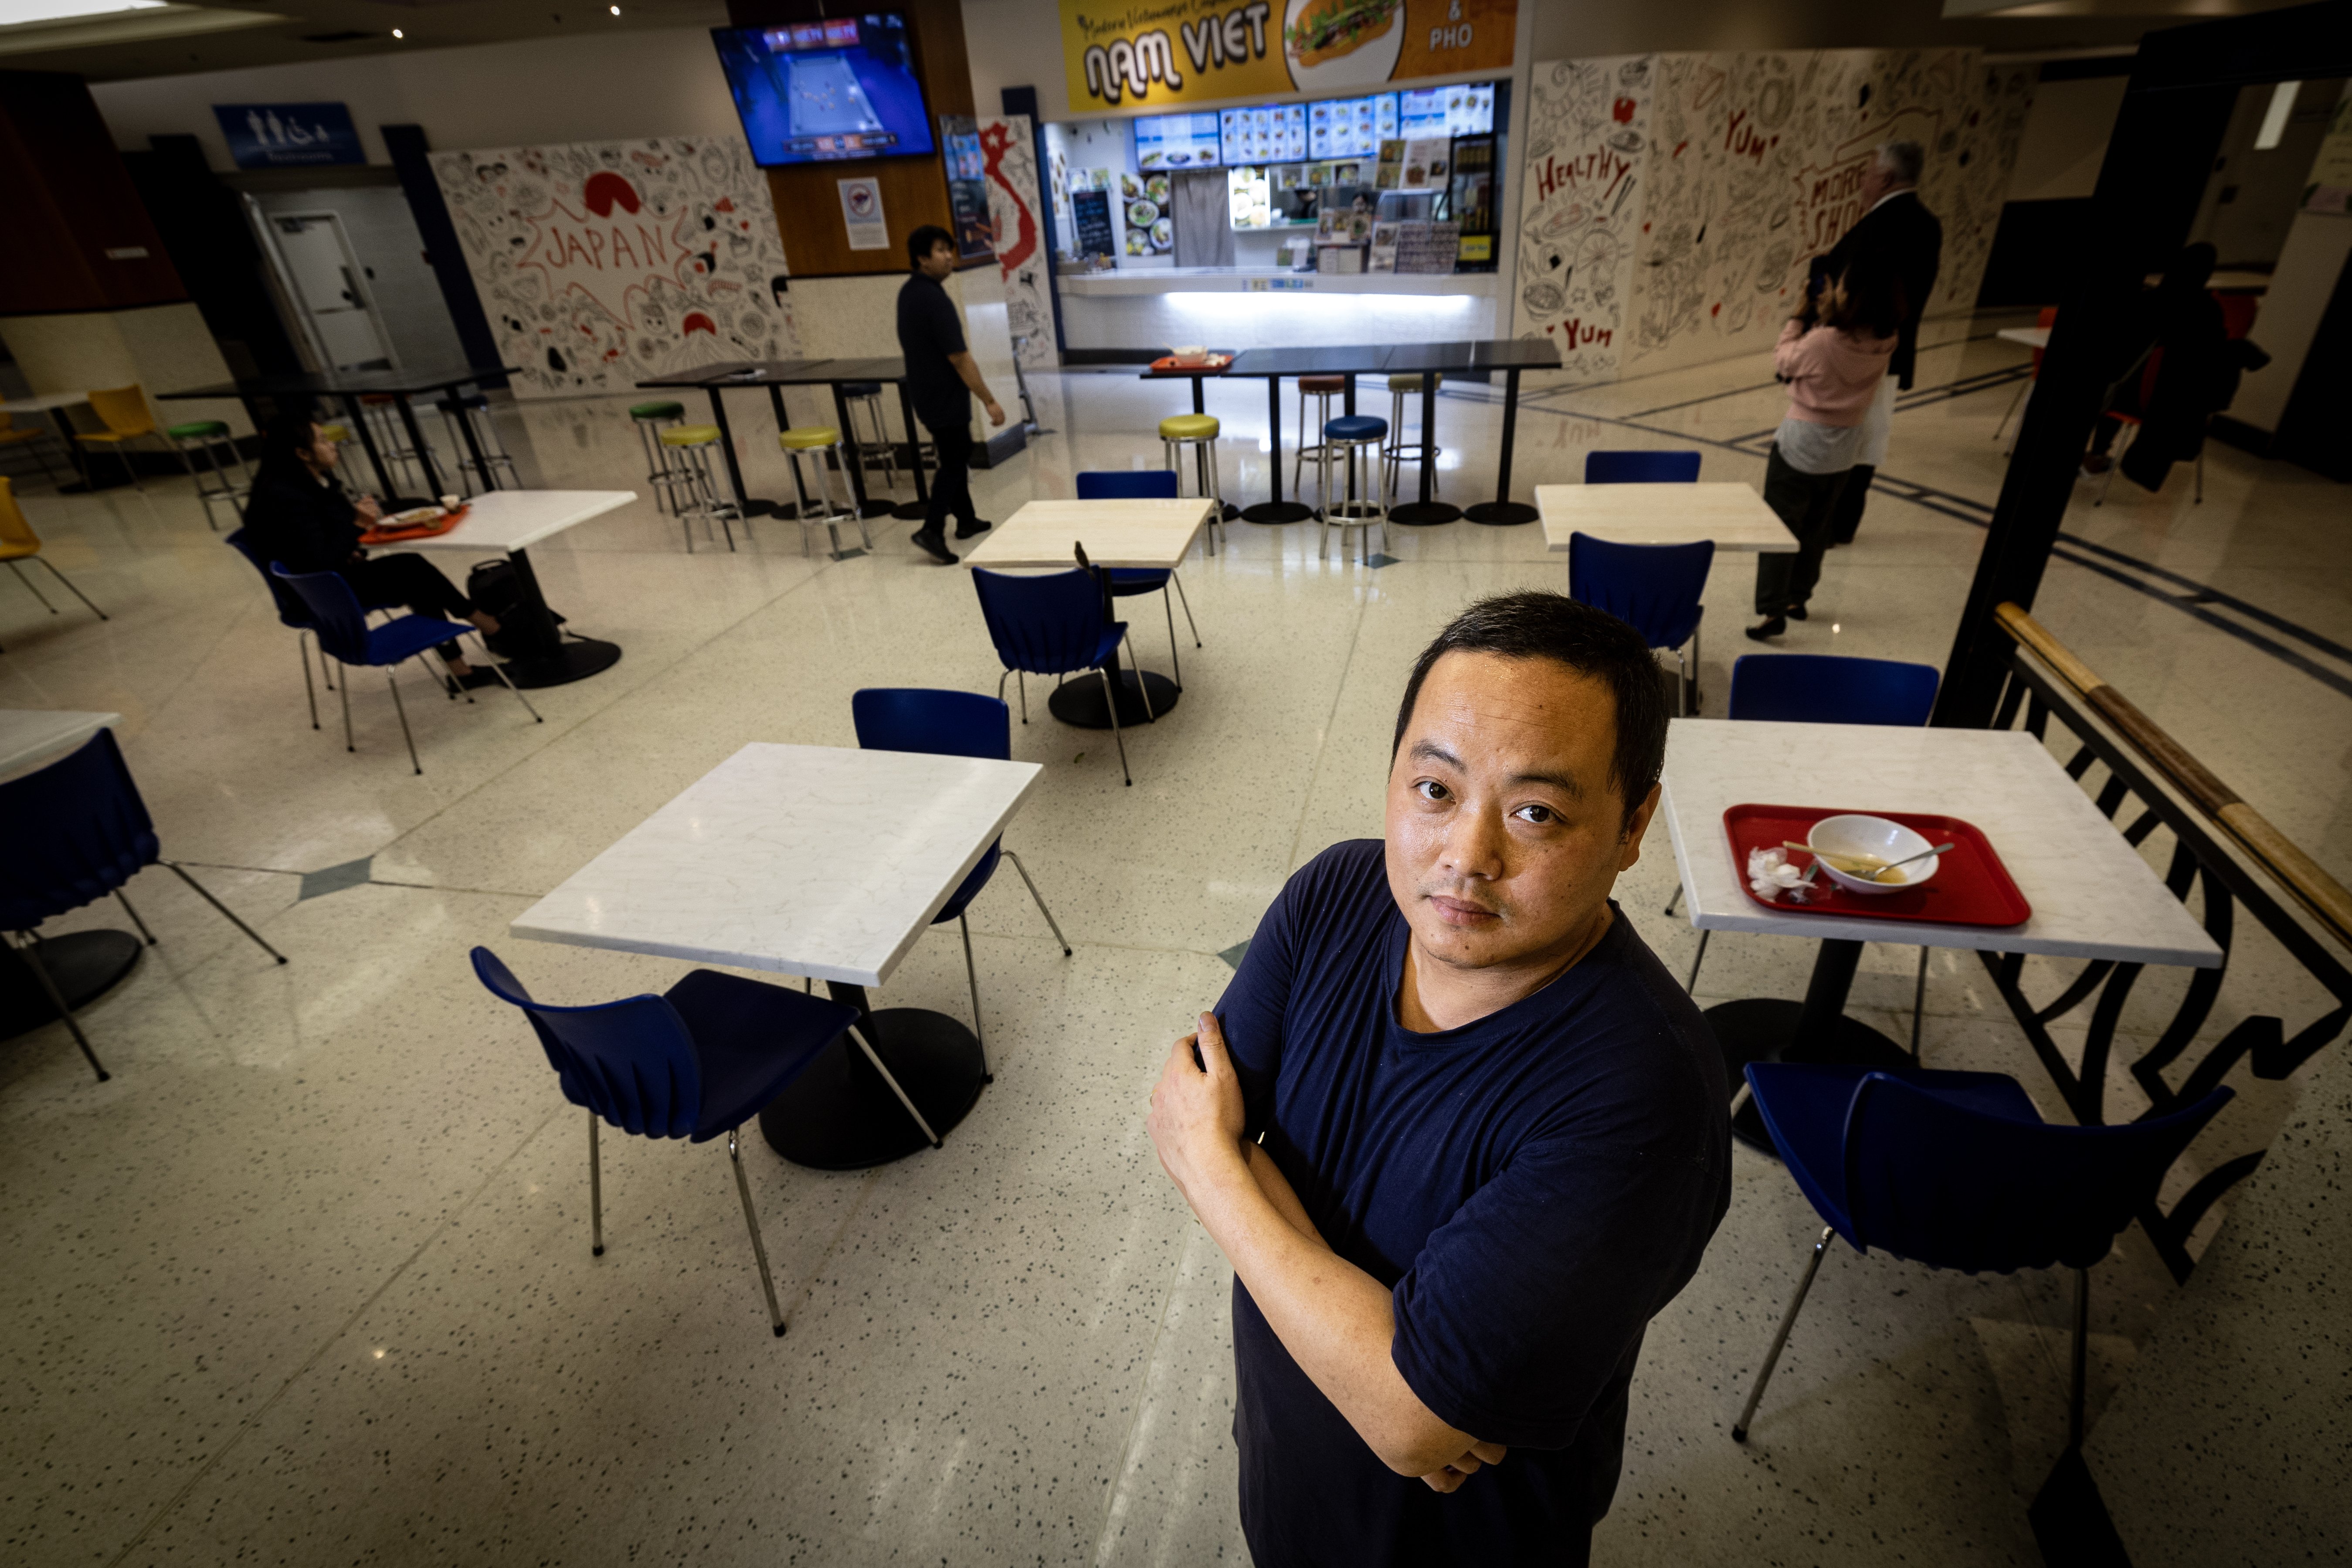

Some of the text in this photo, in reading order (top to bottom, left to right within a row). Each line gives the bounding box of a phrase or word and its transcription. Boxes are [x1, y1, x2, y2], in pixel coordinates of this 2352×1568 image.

[1084, 3, 1270, 105] NAM VIET
[1429, 23, 1473, 52] PHO
[1536, 144, 1631, 201] HEALTHY
[546, 223, 668, 271] JAPAN
